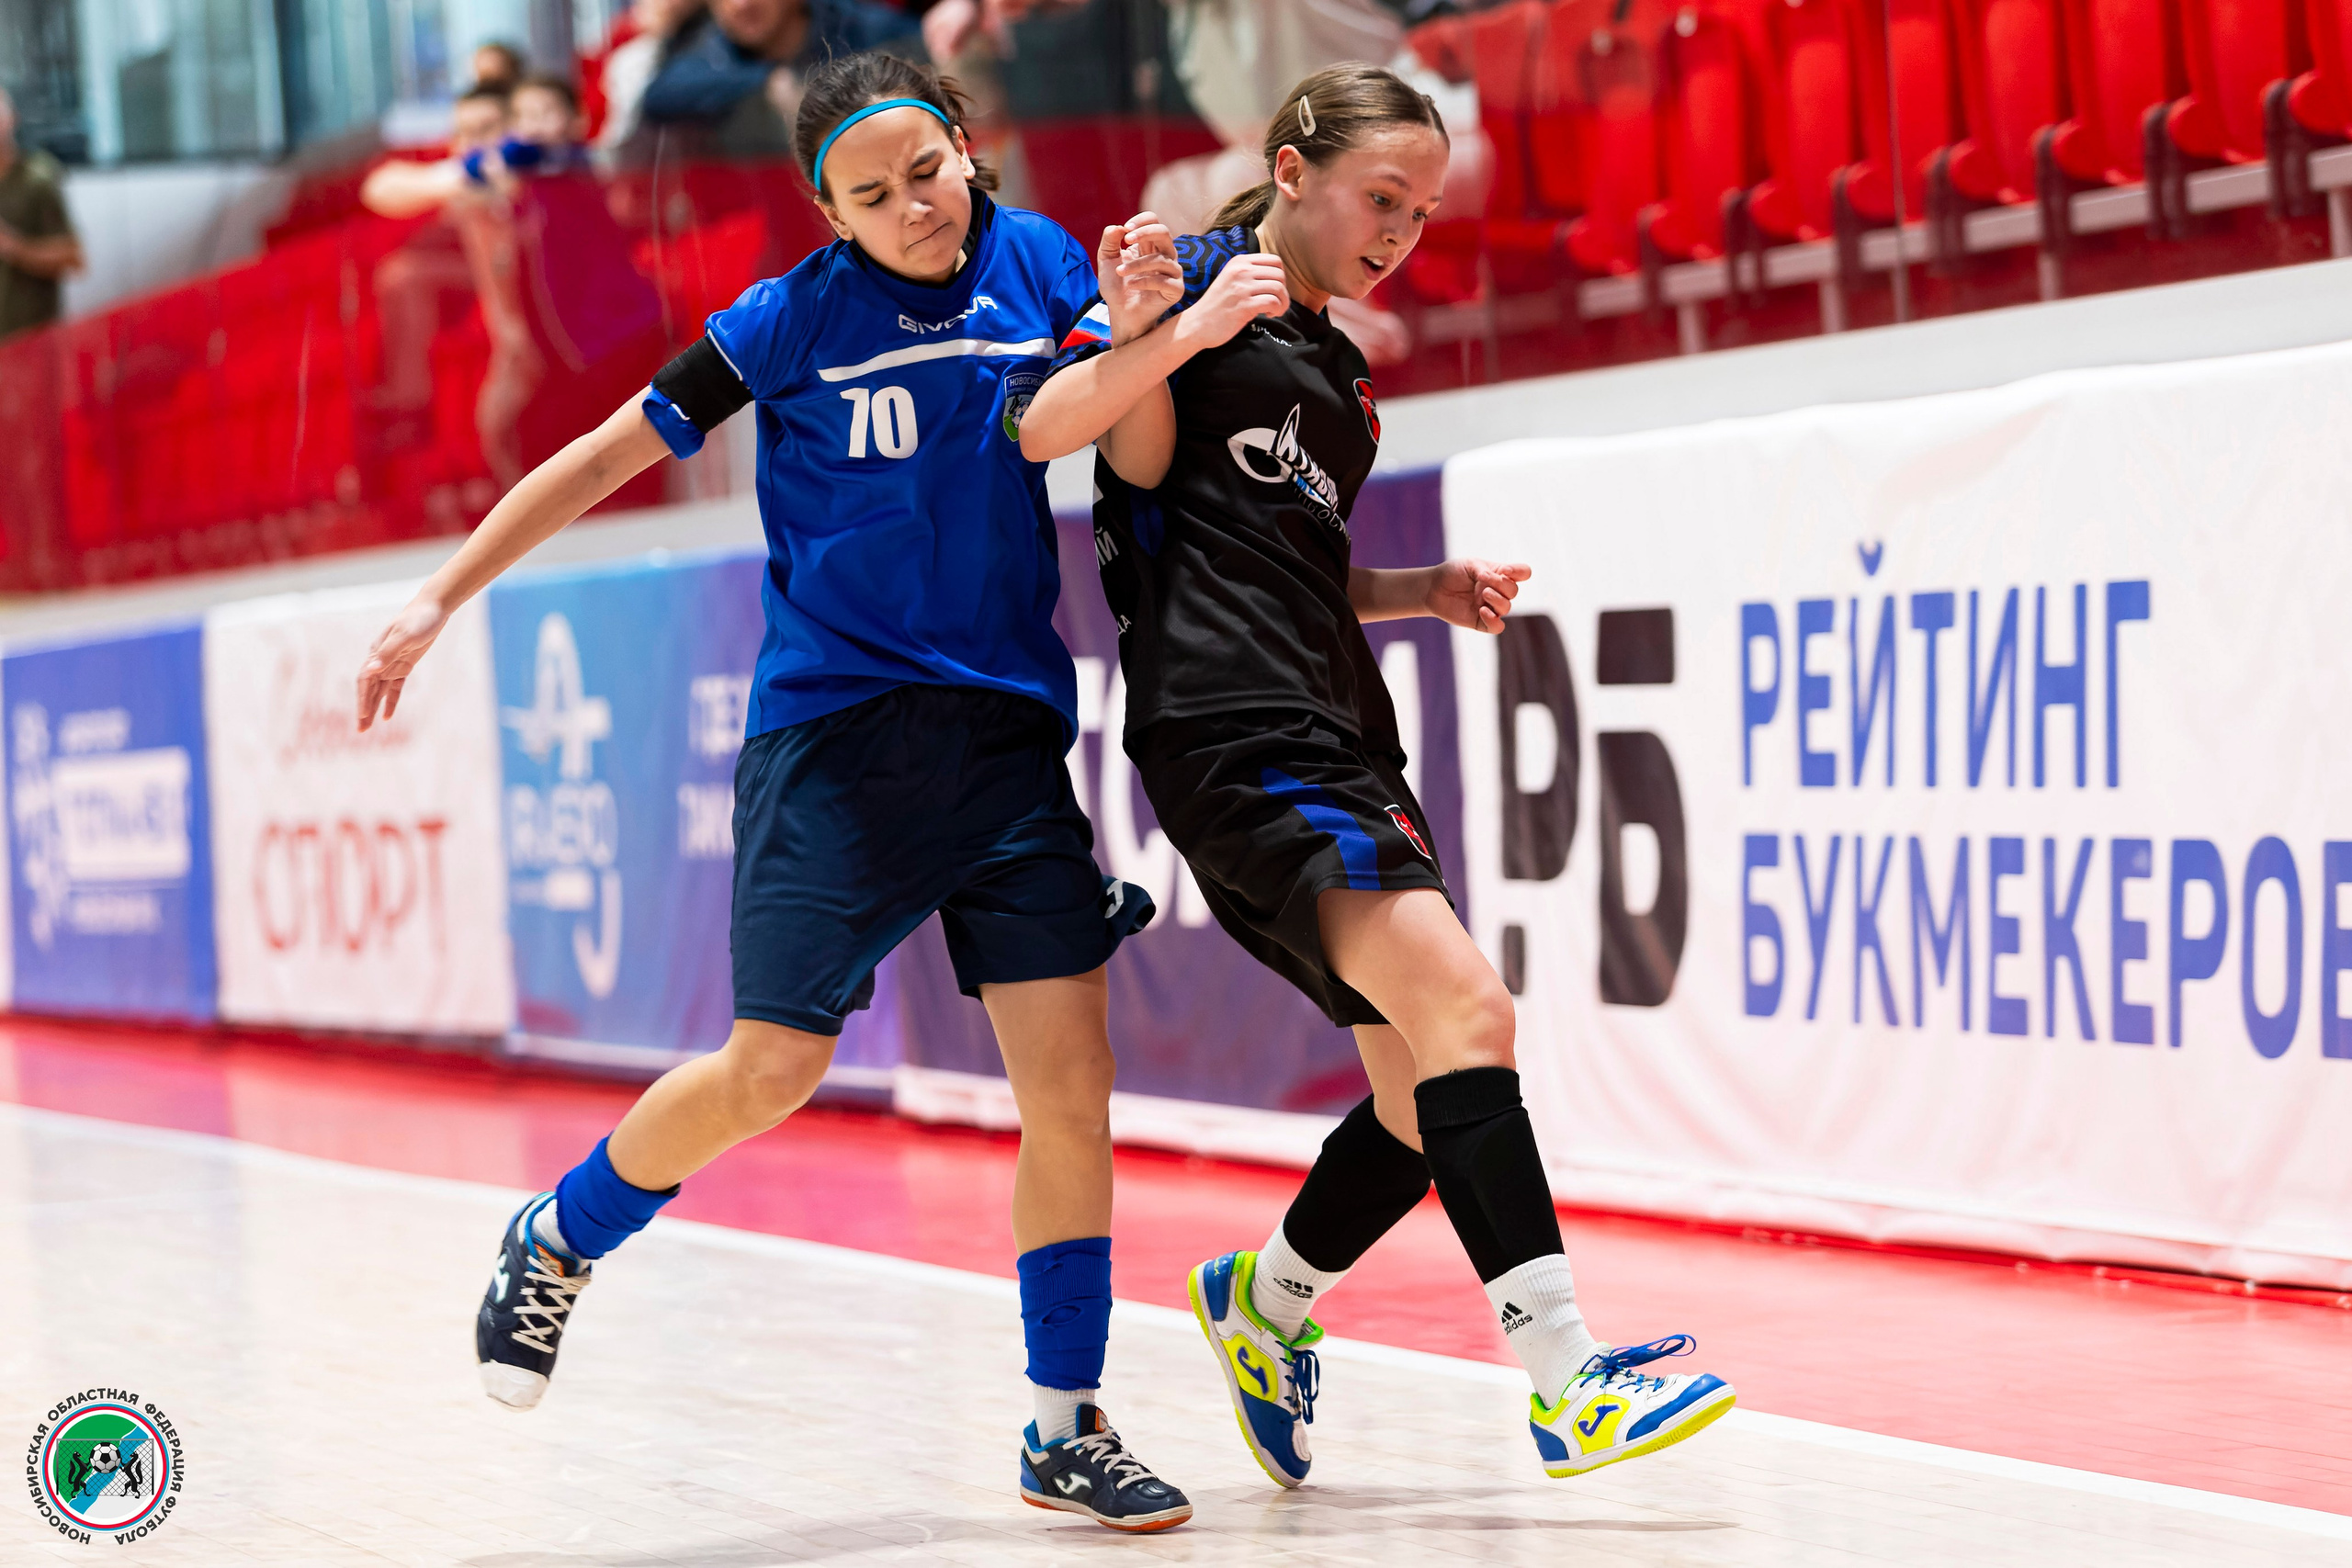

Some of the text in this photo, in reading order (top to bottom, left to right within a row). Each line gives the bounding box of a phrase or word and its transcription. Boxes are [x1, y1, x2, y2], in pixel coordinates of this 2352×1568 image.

[898, 295, 999, 334] GIVOVA
[839, 385, 919, 459] 10
[1739, 540, 2152, 789] РЕЙТИНГ
[1272, 1277, 1313, 1299] adidas
